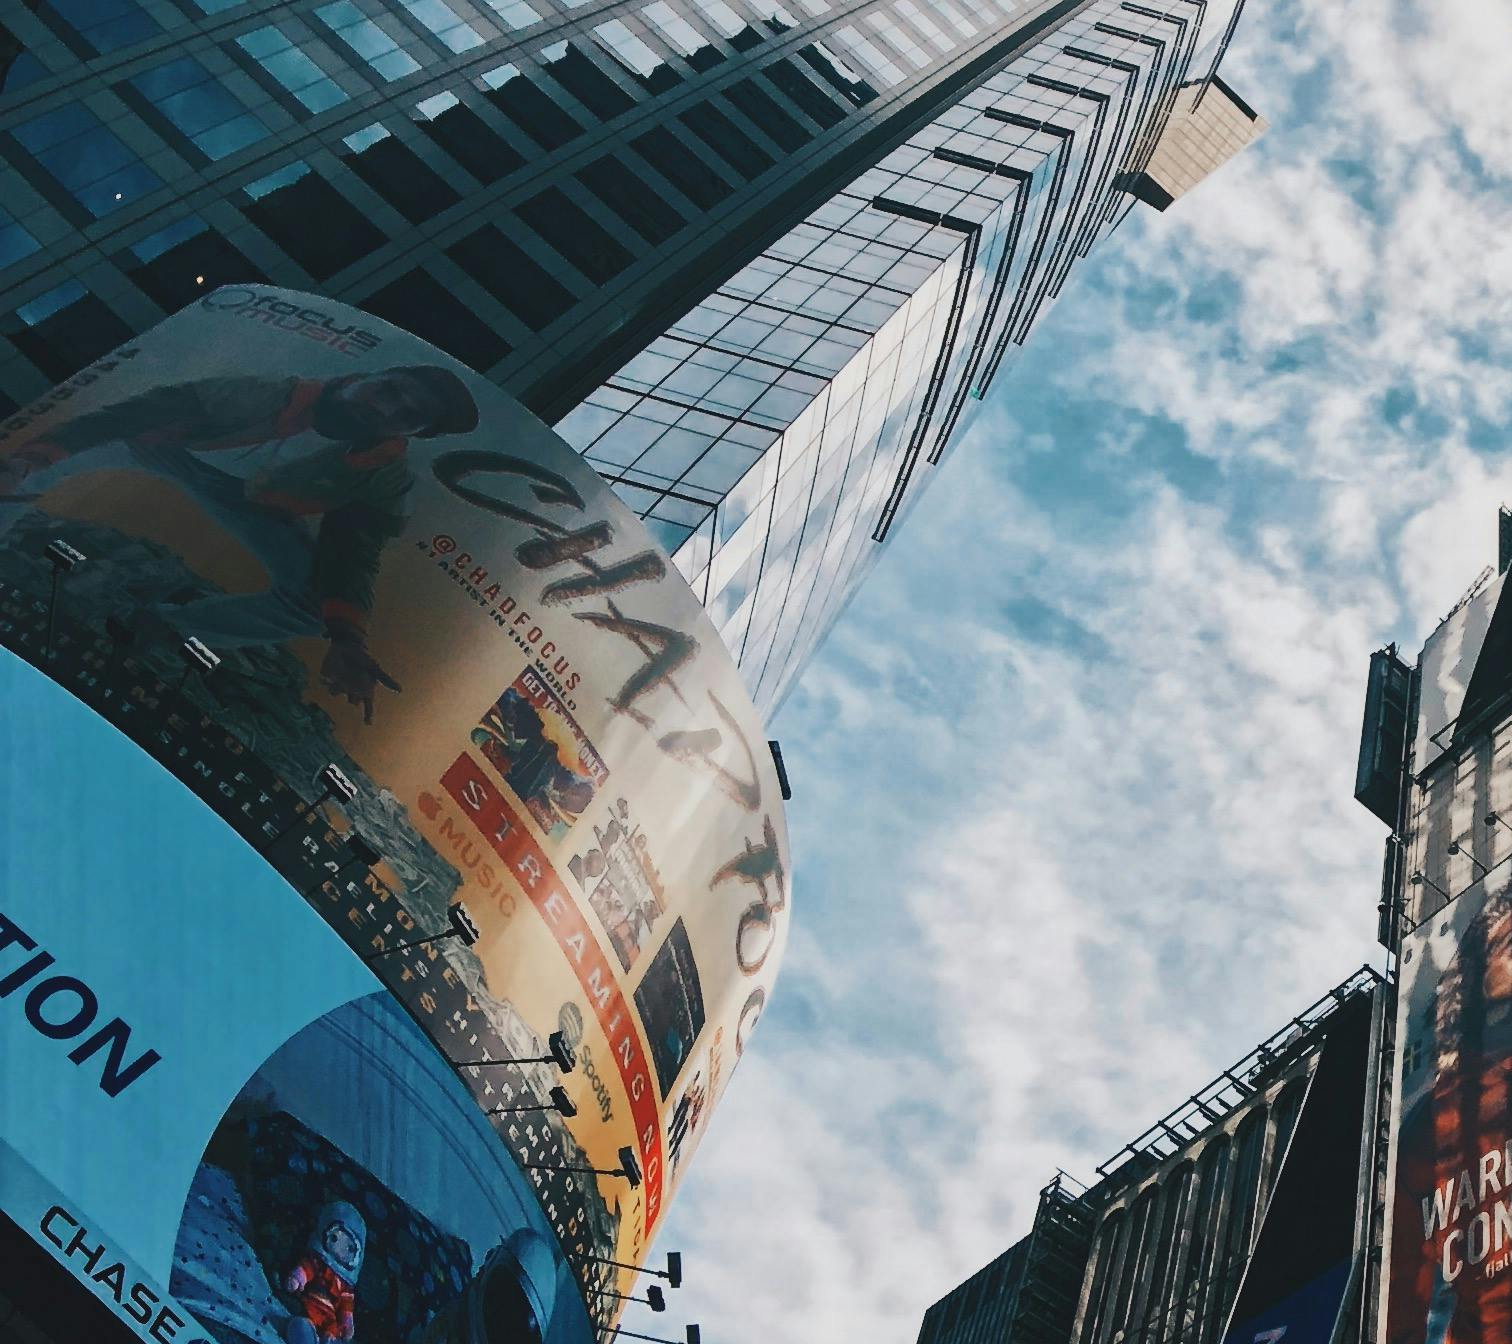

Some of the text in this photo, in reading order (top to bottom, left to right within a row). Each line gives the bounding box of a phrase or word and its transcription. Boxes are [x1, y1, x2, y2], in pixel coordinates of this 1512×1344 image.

[253, 294, 382, 352] focus
[433, 535, 580, 690] @CHADFOCUS
[489, 609, 505, 627] IN
[535, 659, 577, 711] WORLD
[154, 727, 281, 841] SINGLE
[439, 815, 517, 919] MUSIC
[462, 780, 645, 1102] STREAMING
[580, 1043, 614, 1123] Spotify
